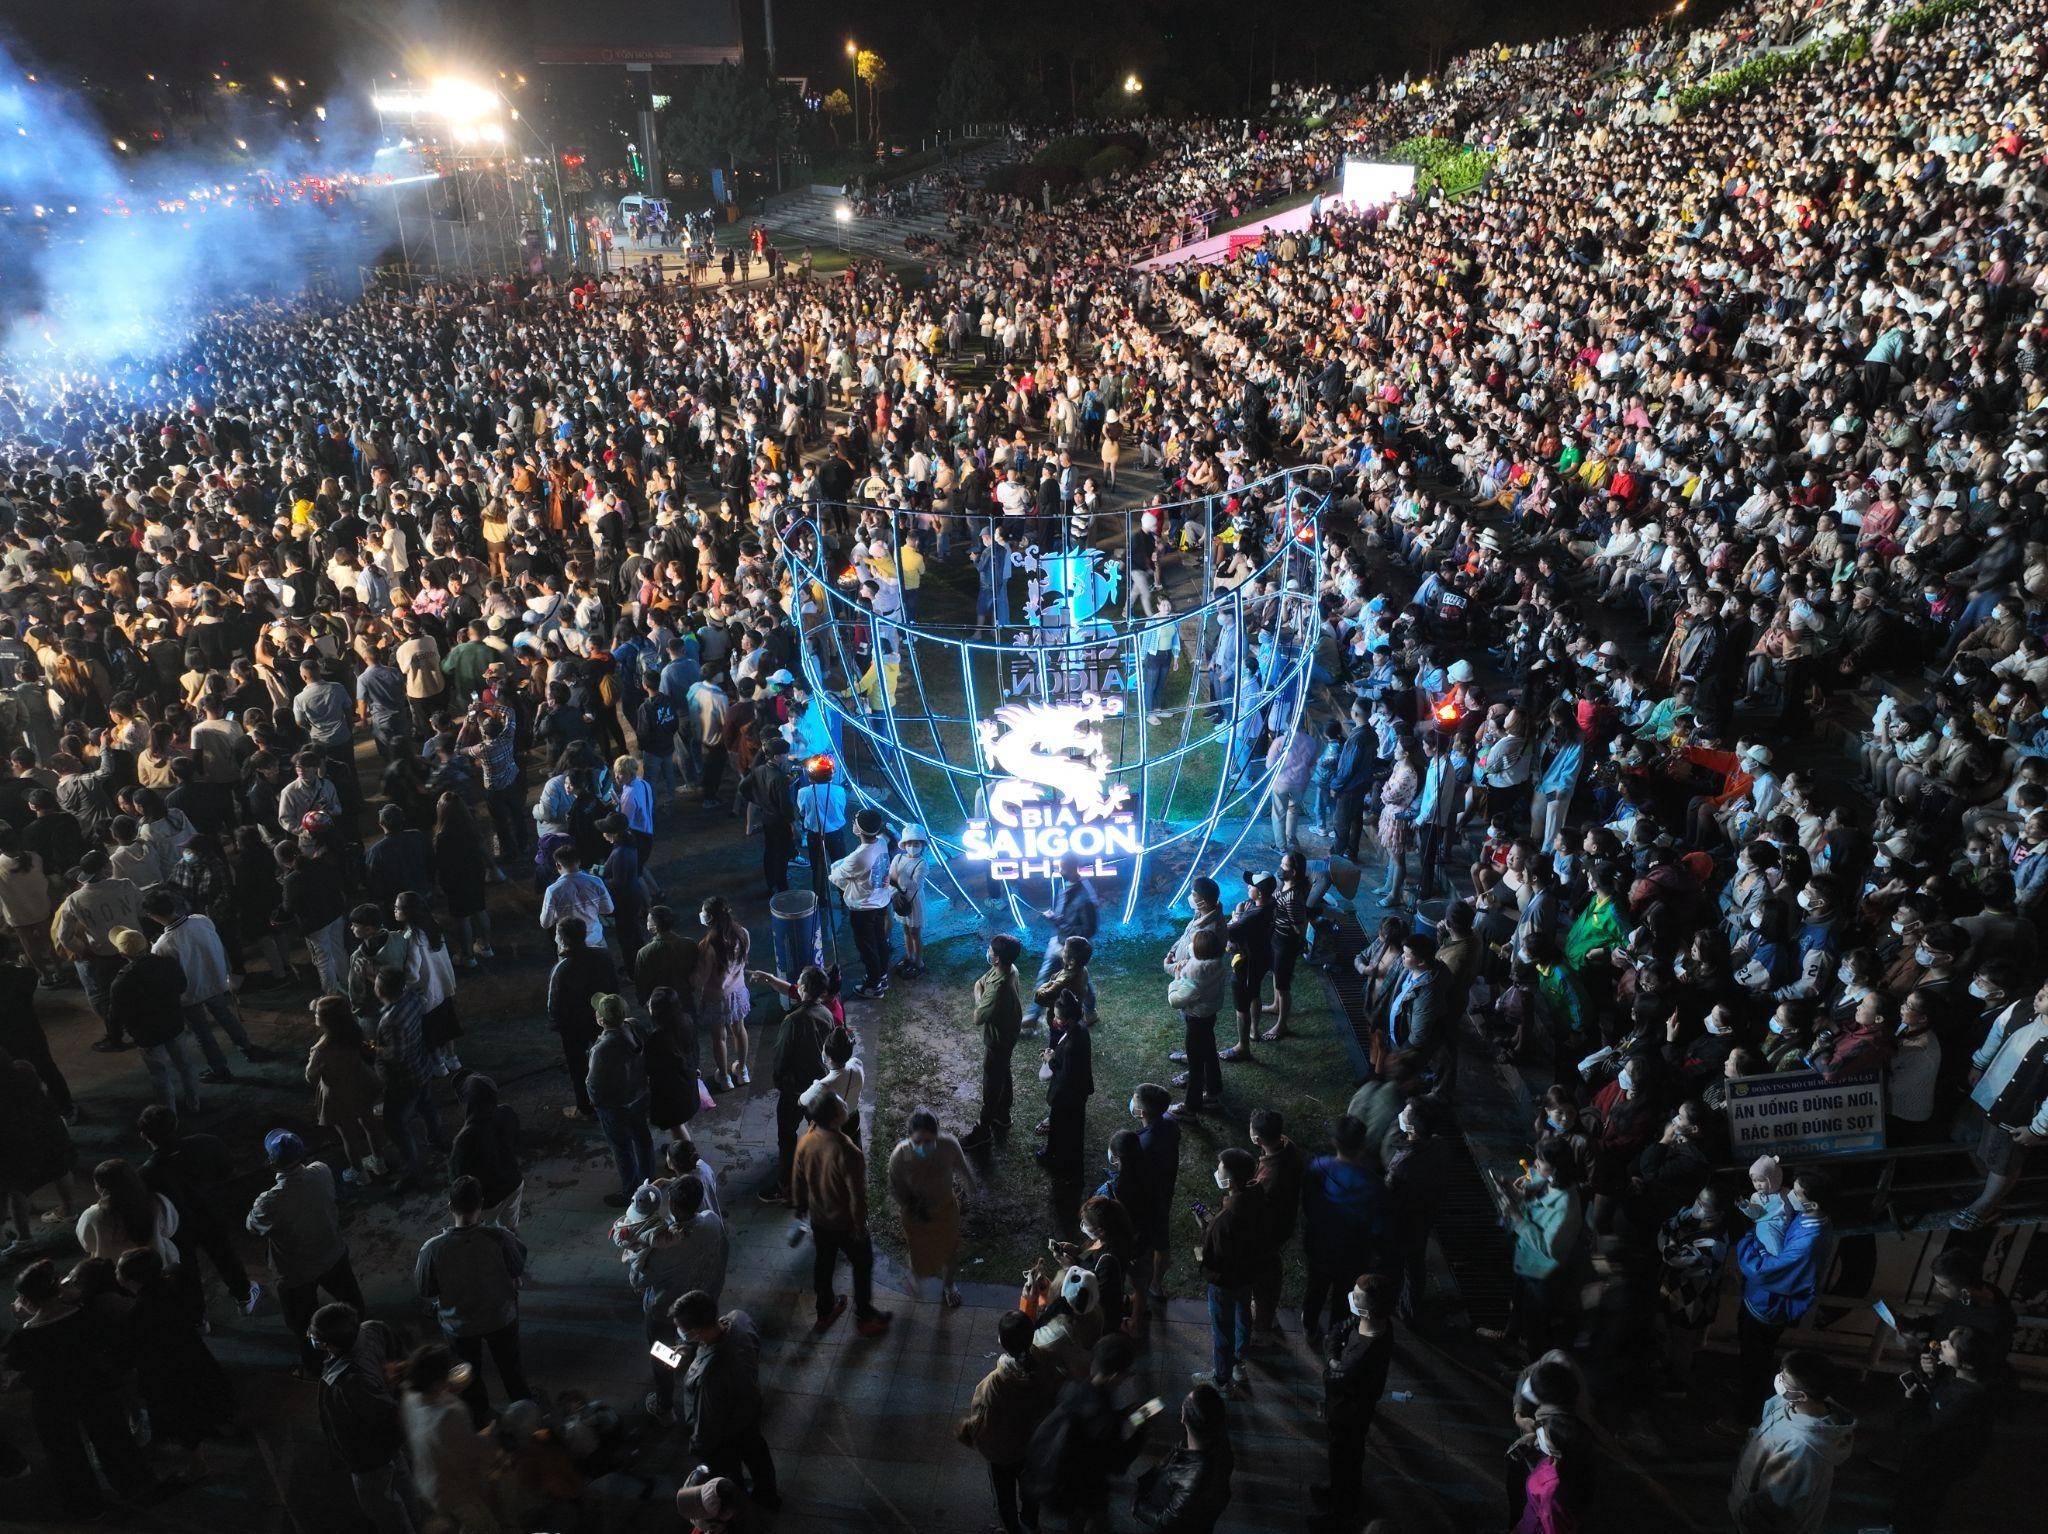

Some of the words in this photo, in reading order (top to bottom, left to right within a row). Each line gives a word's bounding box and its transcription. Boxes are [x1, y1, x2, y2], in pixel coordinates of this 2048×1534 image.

[1021, 806, 1077, 828] BIA
[961, 824, 1138, 860] SAIGON
[1759, 1097, 1799, 1116] UỐNG
[1802, 1094, 1843, 1112] ĐÚNG
[1741, 1123, 1769, 1141] RÁC
[1774, 1121, 1798, 1137] RƠI
[1802, 1117, 1842, 1134] ĐÚNG
[1847, 1114, 1874, 1132] SỌT
